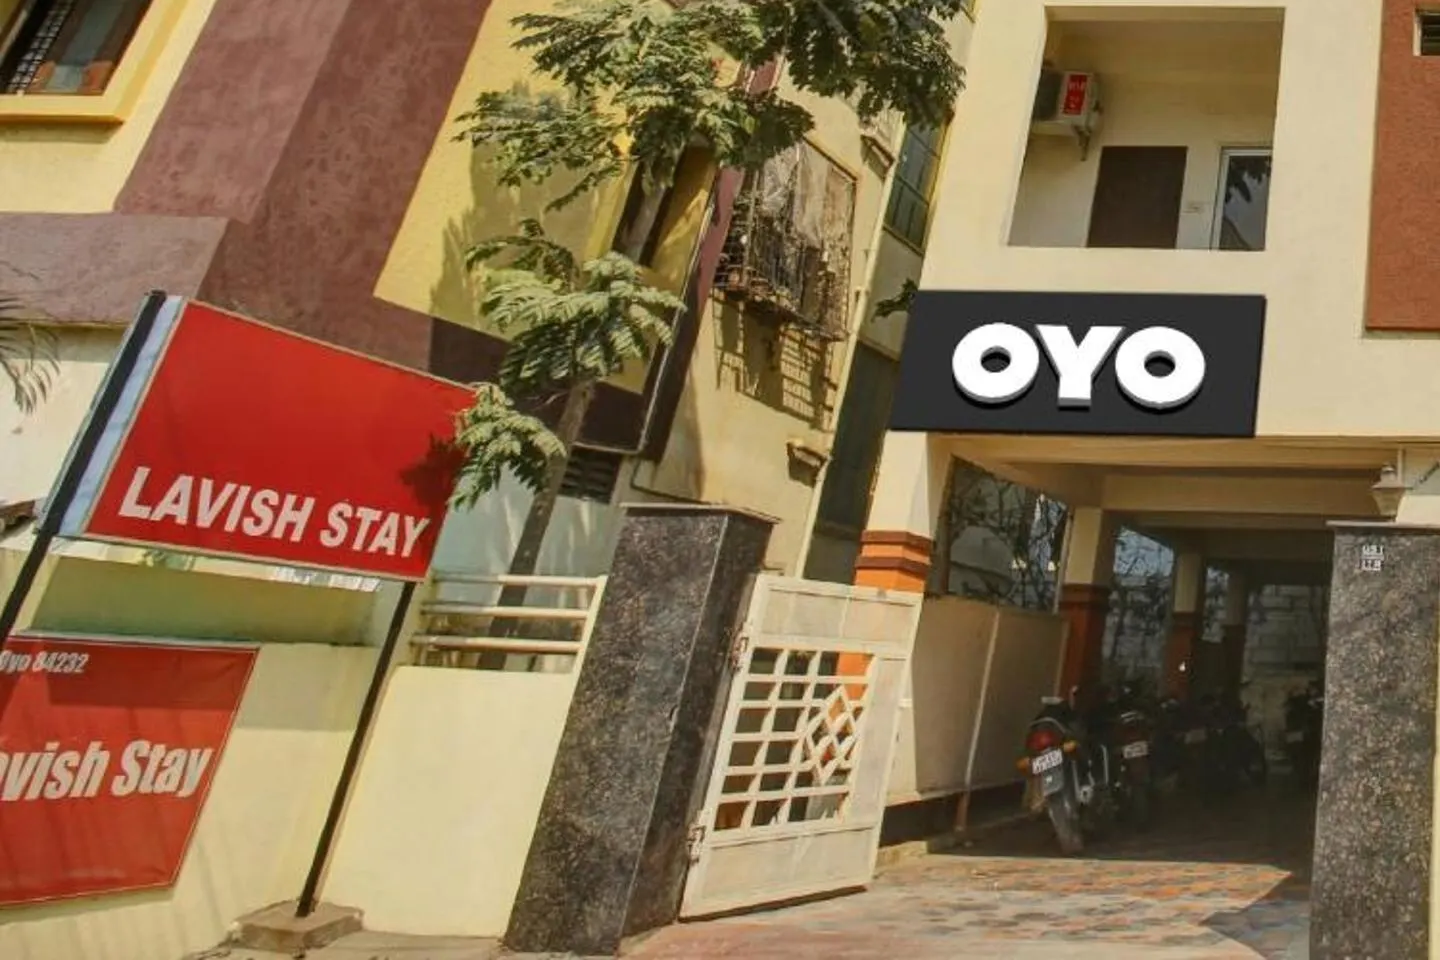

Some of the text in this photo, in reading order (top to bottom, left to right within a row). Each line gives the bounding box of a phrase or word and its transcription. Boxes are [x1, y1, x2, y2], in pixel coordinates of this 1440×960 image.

[952, 322, 1206, 410] OYO
[118, 466, 430, 558] LAVISH STAY
[111, 739, 214, 798] Stay
